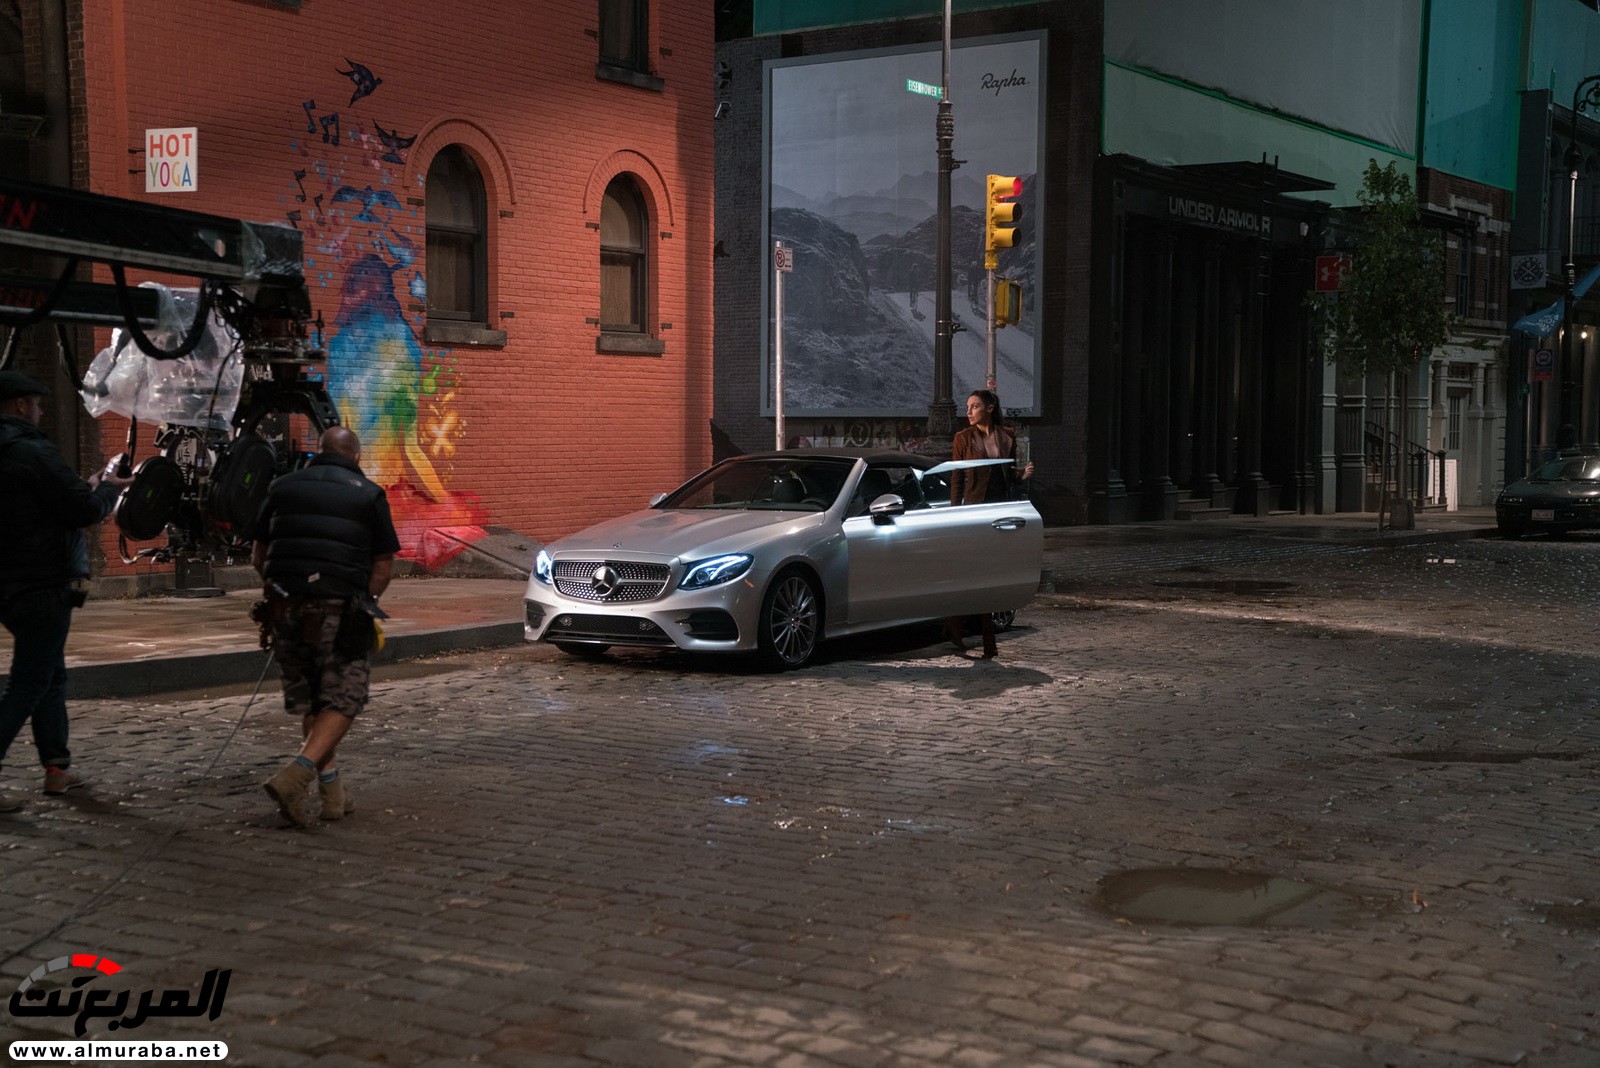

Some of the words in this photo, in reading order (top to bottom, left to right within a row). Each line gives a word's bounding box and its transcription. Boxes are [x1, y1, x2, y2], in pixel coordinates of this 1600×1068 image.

[907, 80, 938, 97] EISENHOWER
[149, 132, 193, 158] HOT
[149, 161, 193, 188] YOGA
[1168, 196, 1215, 223] UNDER
